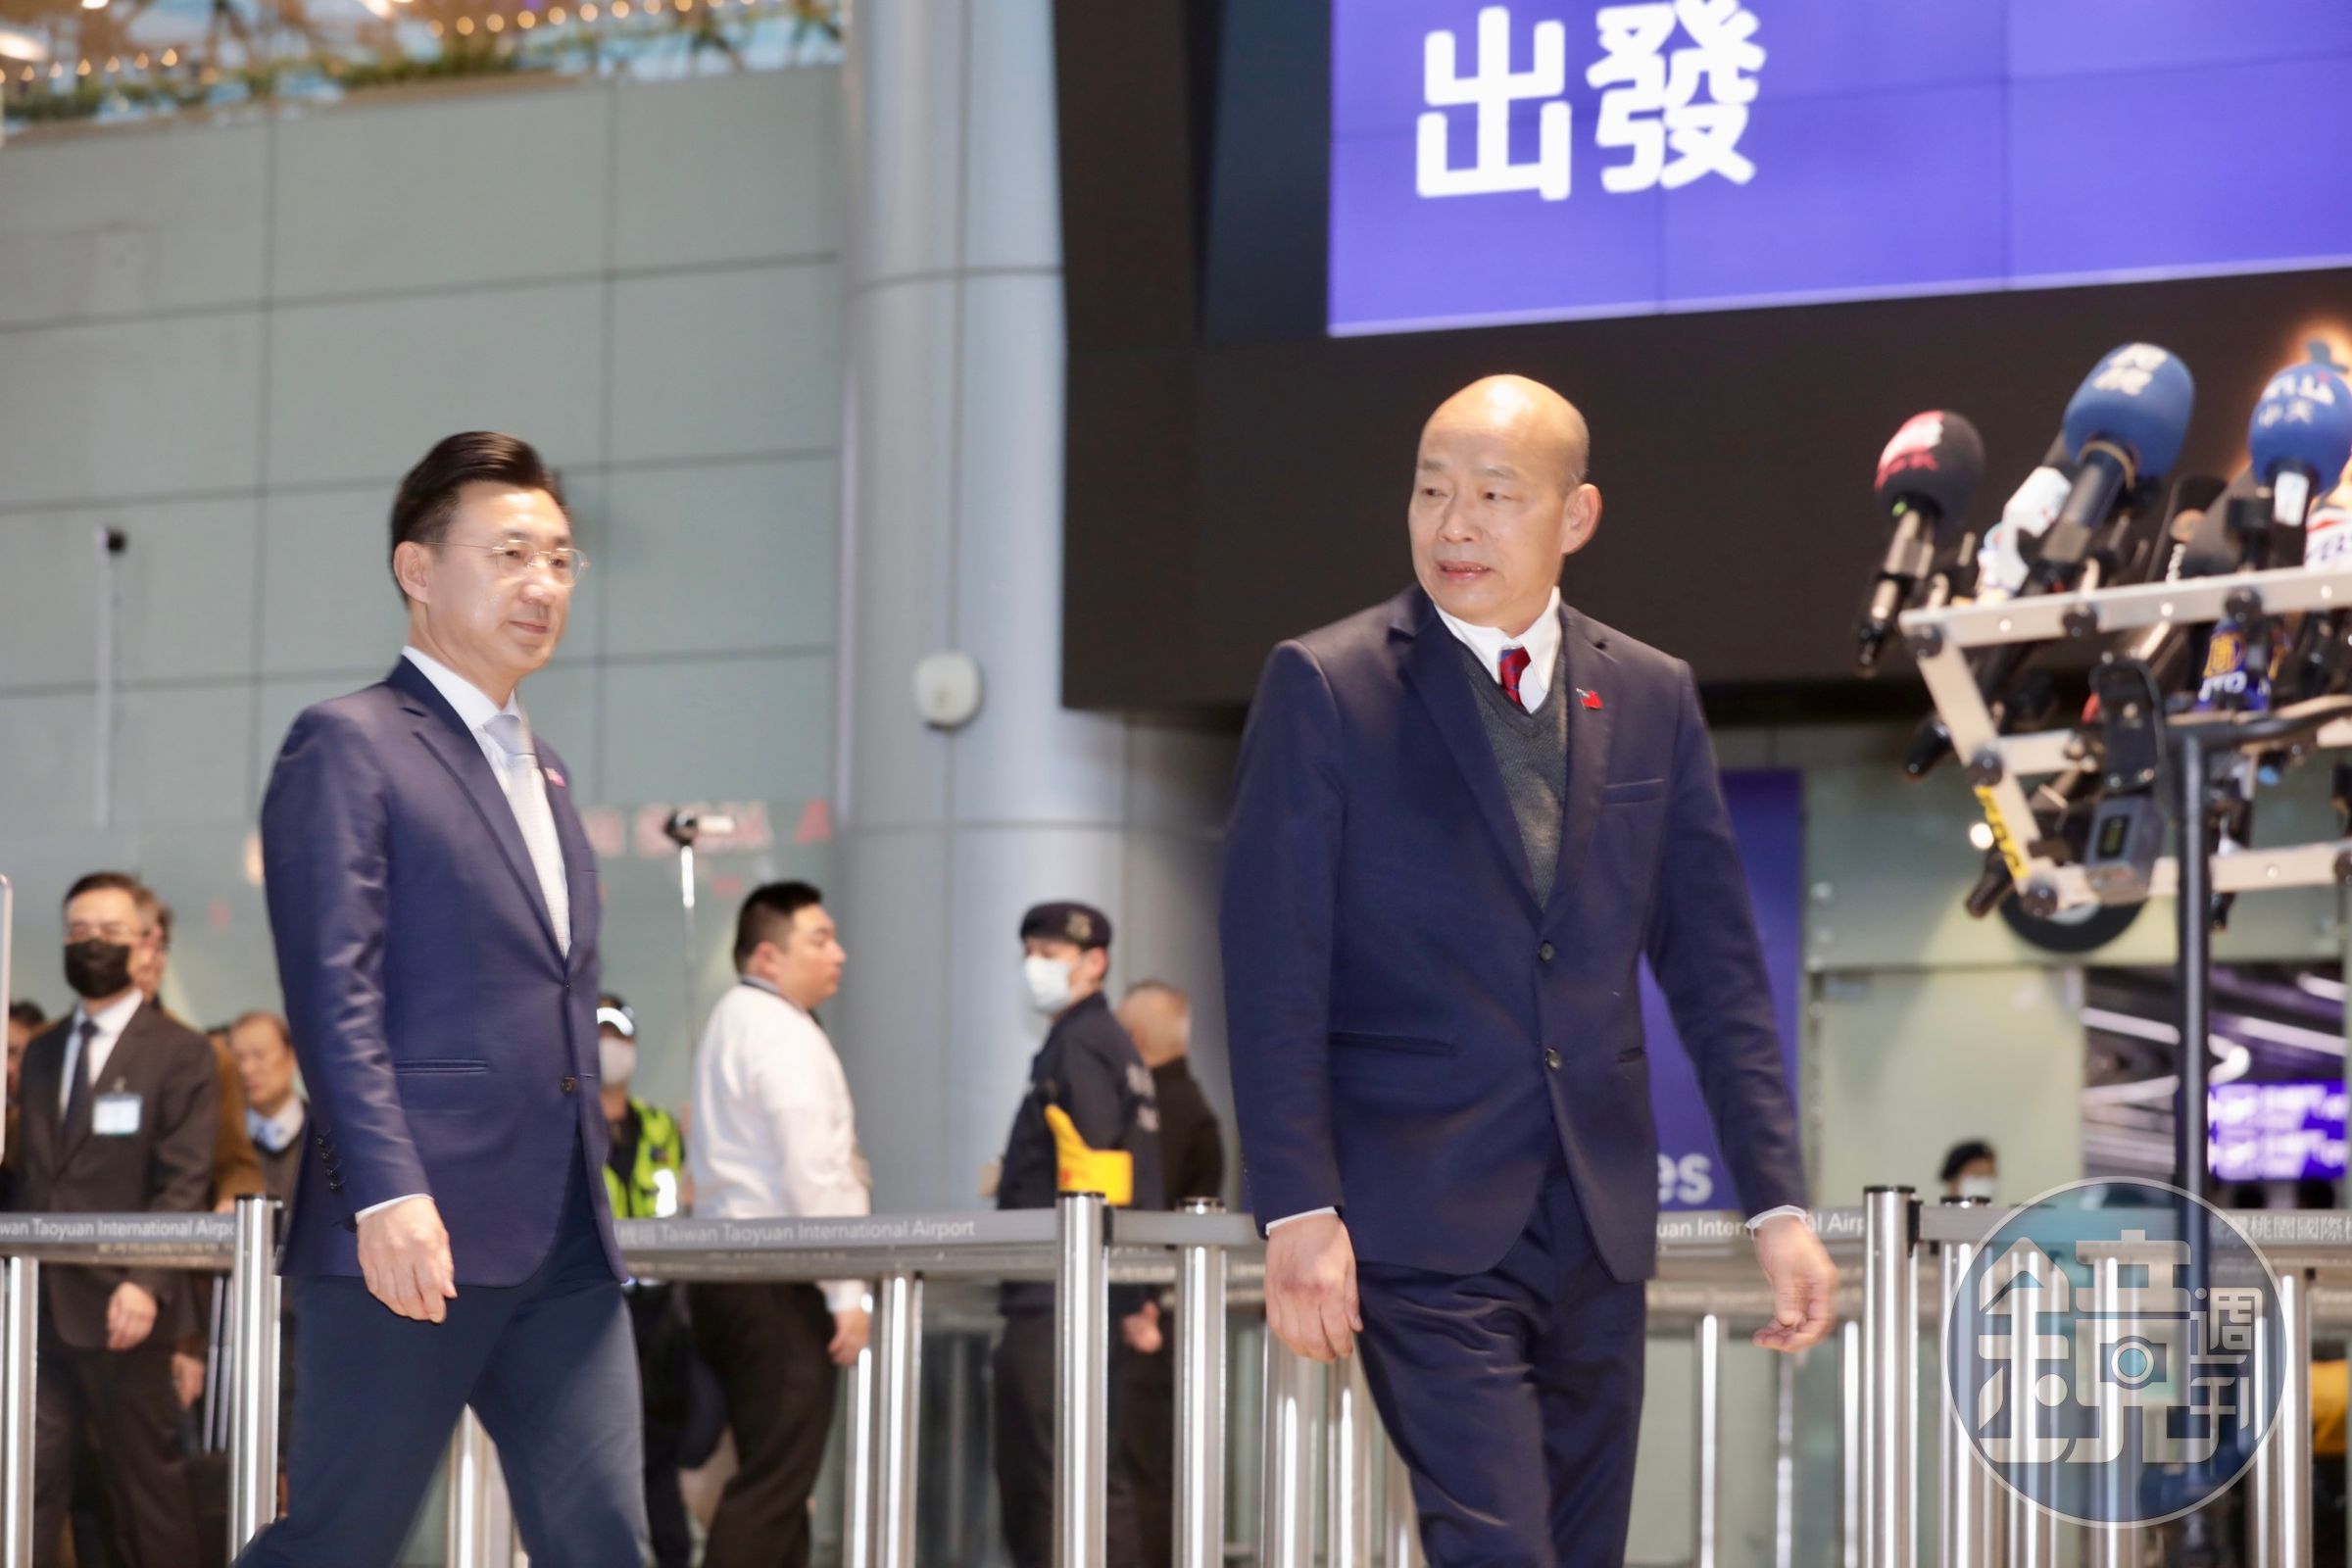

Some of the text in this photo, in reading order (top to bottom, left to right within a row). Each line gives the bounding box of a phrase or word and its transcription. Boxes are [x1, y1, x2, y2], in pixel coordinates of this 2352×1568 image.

[1416, 0, 1767, 201] 出發
[32, 1218, 94, 1241] Taoyuan
[99, 1218, 193, 1237] International
[661, 1224, 717, 1243] Taiwan
[722, 1223, 794, 1246] Taoyuan
[798, 1219, 908, 1240] International
[912, 1218, 976, 1239] Airport
